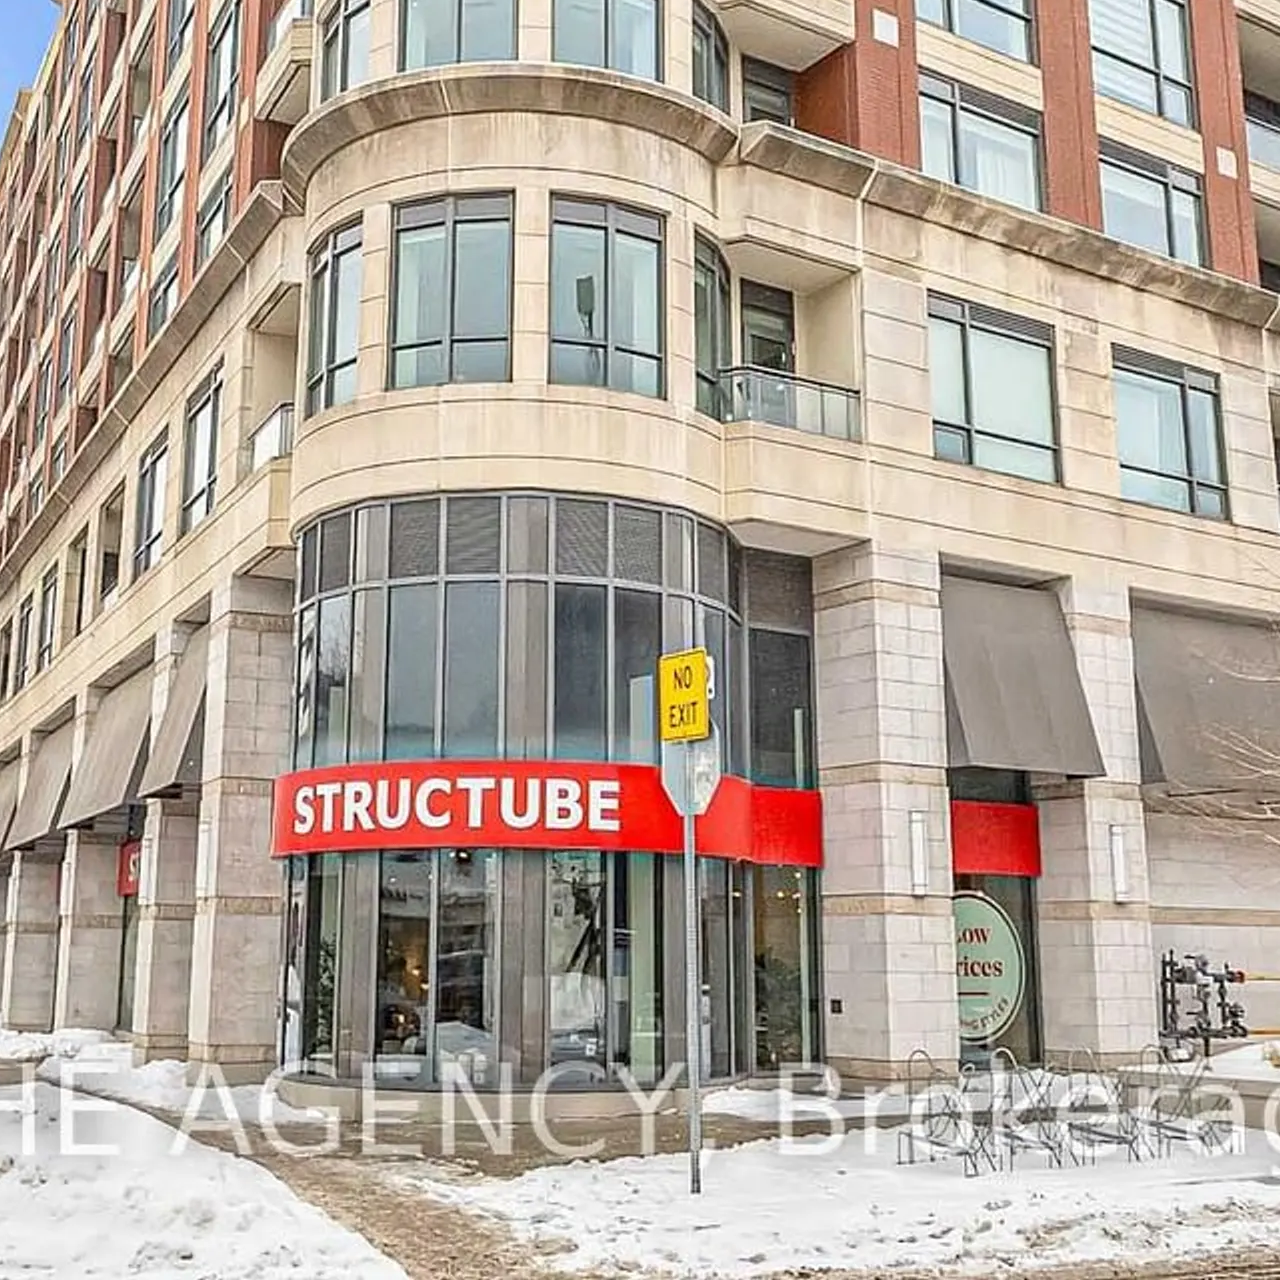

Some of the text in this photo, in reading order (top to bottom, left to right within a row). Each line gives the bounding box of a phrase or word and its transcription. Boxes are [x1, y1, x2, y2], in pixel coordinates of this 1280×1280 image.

[673, 665, 694, 690] NO
[669, 701, 699, 728] EXIT
[293, 776, 621, 835] STRUCTUBE
[957, 956, 1003, 978] rices
